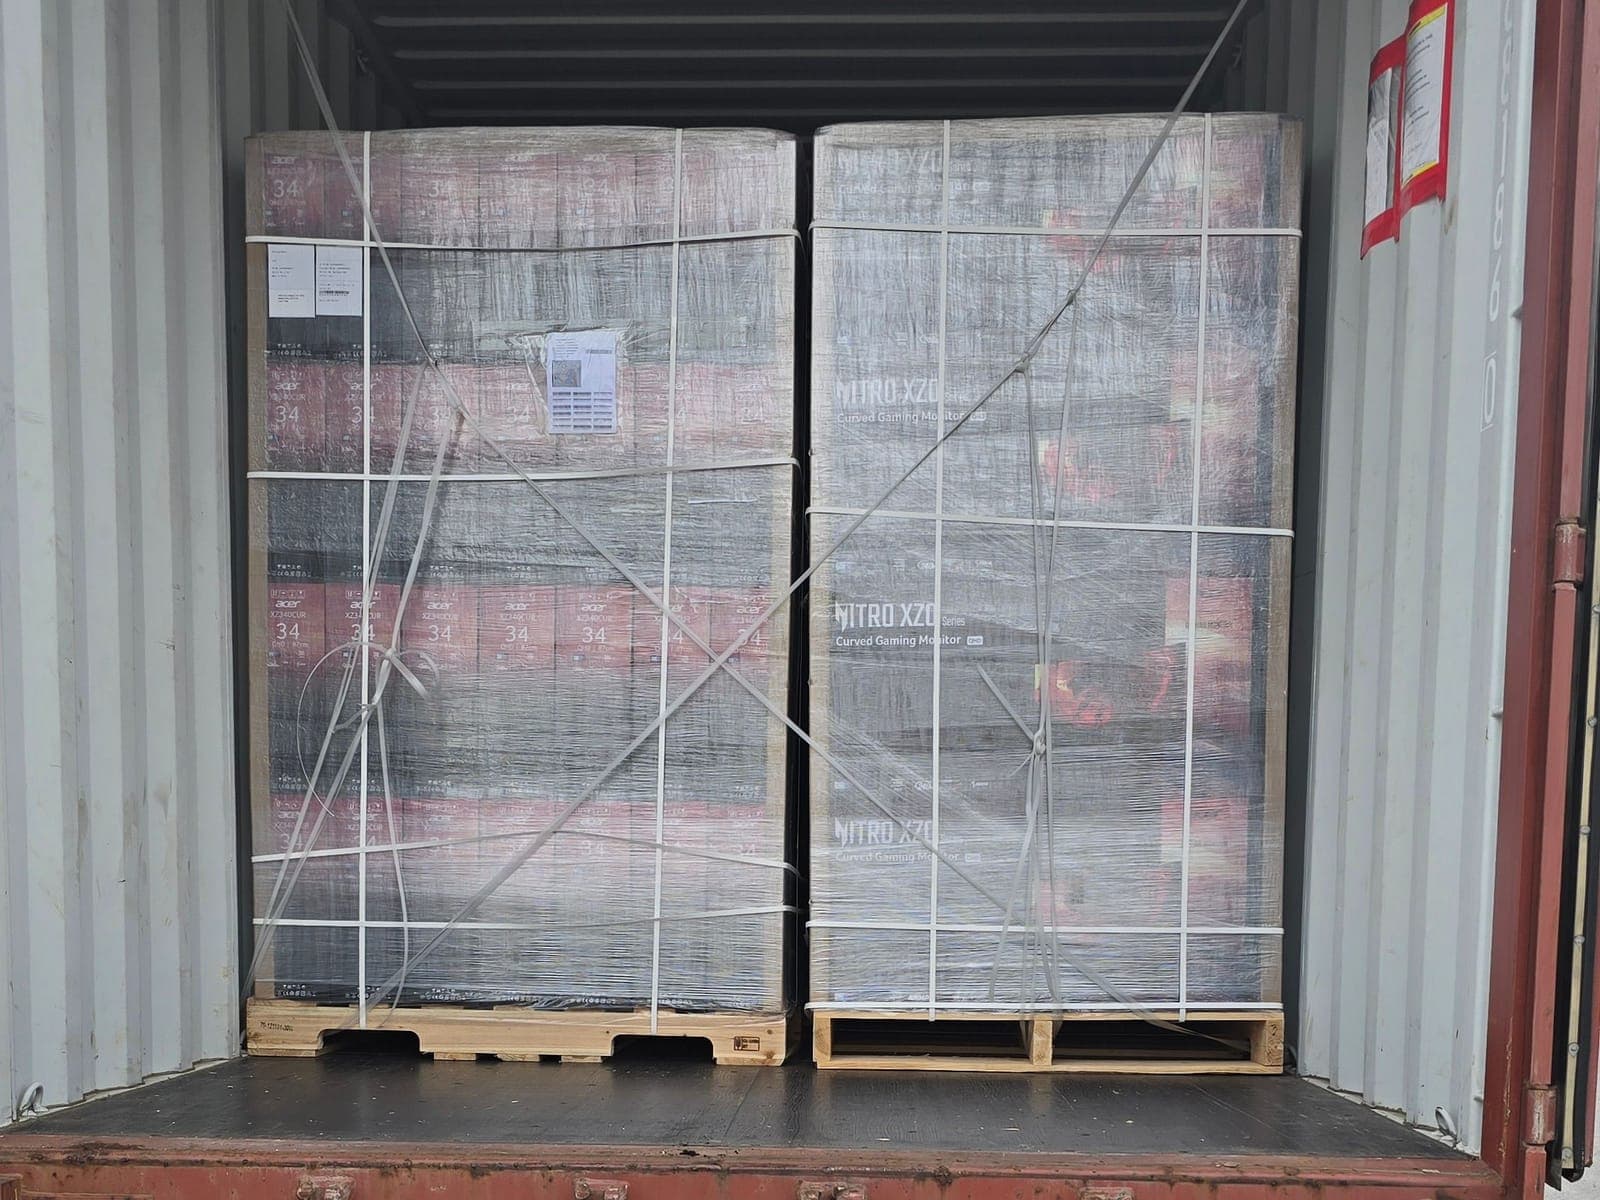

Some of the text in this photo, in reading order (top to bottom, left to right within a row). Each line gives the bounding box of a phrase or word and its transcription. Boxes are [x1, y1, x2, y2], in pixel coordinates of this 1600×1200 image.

[273, 180, 300, 198] 34
[275, 382, 300, 390] acer
[351, 382, 377, 391] acr
[275, 405, 299, 423] 34
[838, 411, 964, 425] Curved Gaming Moitor
[275, 600, 301, 608] acer
[350, 601, 377, 609] acr
[427, 602, 453, 610] acer
[504, 602, 530, 611] acer
[581, 604, 607, 612] acer
[736, 605, 763, 614] acer
[345, 612, 383, 620] XZ3CUR
[835, 600, 894, 632] NITRO
[942, 616, 966, 627] Series
[276, 622, 300, 641] 34
[428, 625, 452, 642] 34
[505, 625, 529, 642] 34
[582, 627, 607, 644] 34
[836, 635, 873, 646] Curved
[875, 635, 916, 648] Gaming
[919, 635, 962, 645] Moitor
[834, 817, 893, 848] NITRO
[836, 853, 872, 862] Curved
[876, 852, 914, 863] Gaming
